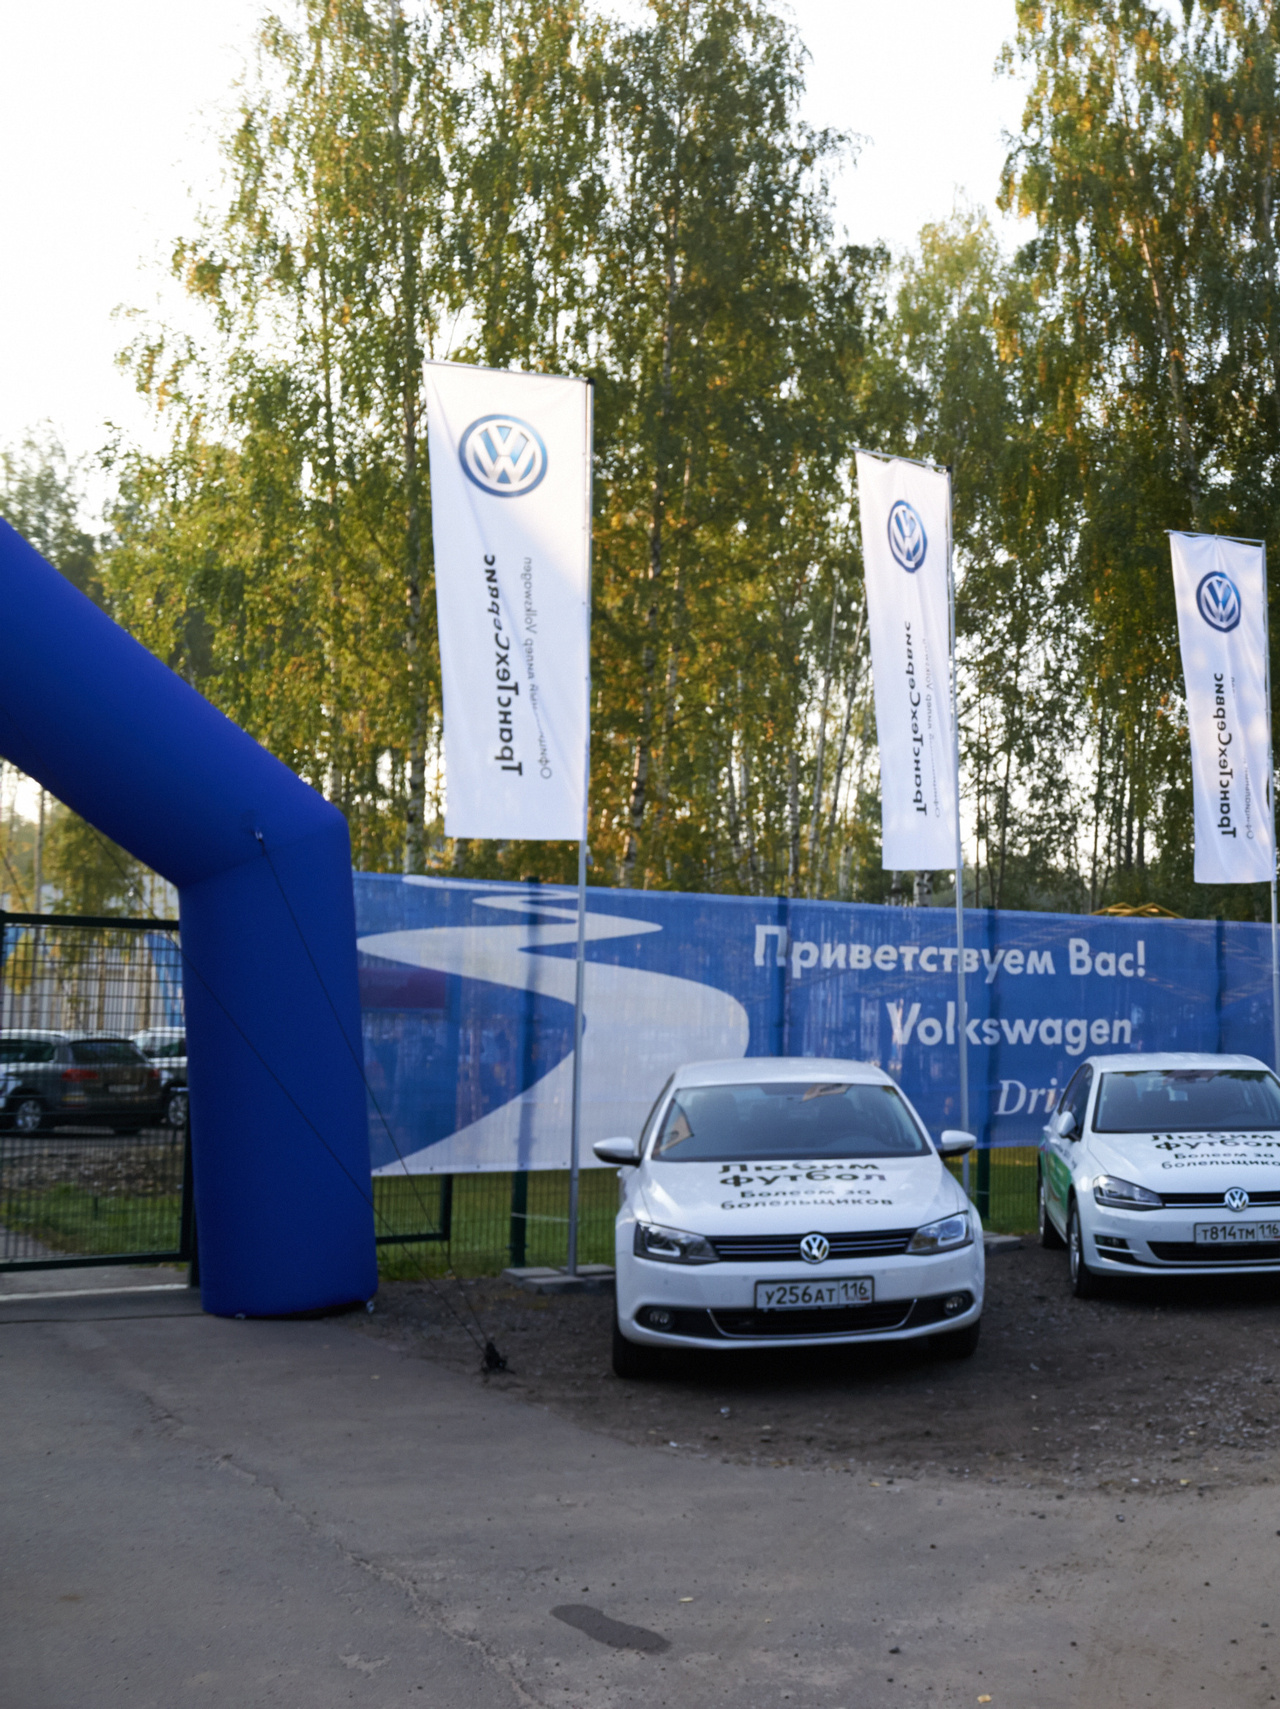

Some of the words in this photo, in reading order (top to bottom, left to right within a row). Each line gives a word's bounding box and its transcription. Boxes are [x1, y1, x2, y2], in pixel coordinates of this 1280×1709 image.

[753, 924, 1055, 982] Приветствуем
[1068, 938, 1147, 978] Вас!
[886, 1001, 1133, 1056] Volkswagen
[993, 1077, 1064, 1115] Dri
[1259, 1223, 1279, 1235] 116
[841, 1282, 868, 1297] 116
